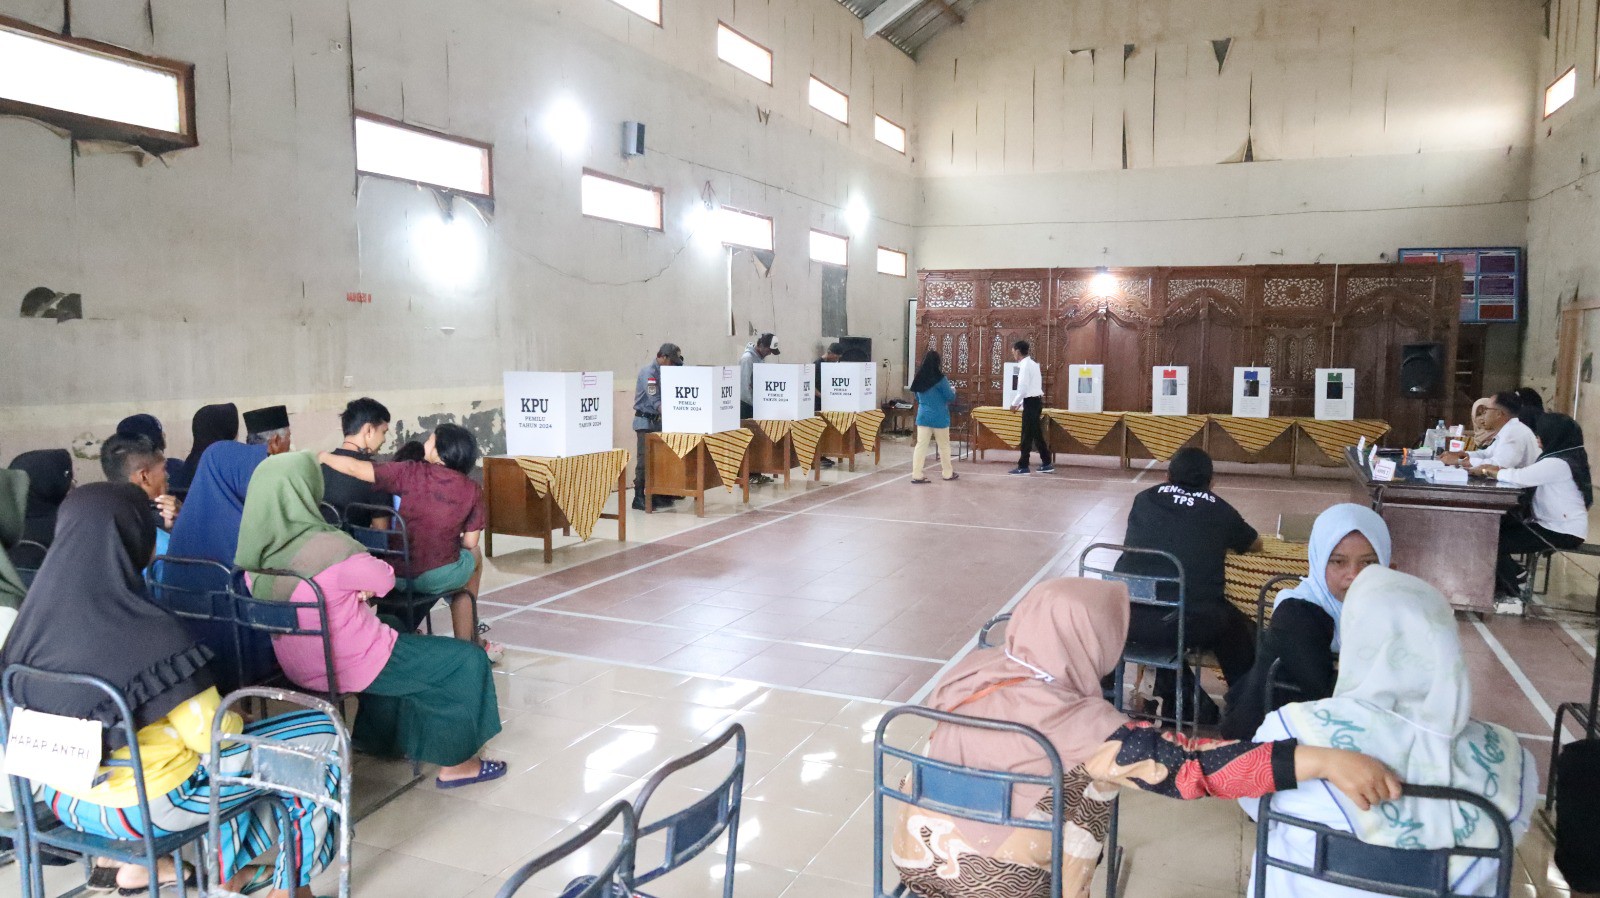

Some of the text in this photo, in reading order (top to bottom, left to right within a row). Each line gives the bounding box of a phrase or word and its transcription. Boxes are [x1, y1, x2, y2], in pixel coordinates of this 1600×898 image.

[765, 381, 786, 391] KPU
[832, 378, 850, 386] KPU
[675, 386, 699, 399] KPU
[721, 386, 733, 399] KPU
[520, 397, 549, 413] KPU
[580, 397, 600, 413] KPU
[1173, 494, 1195, 507] TPS
[52, 743, 90, 760] ANTRI
